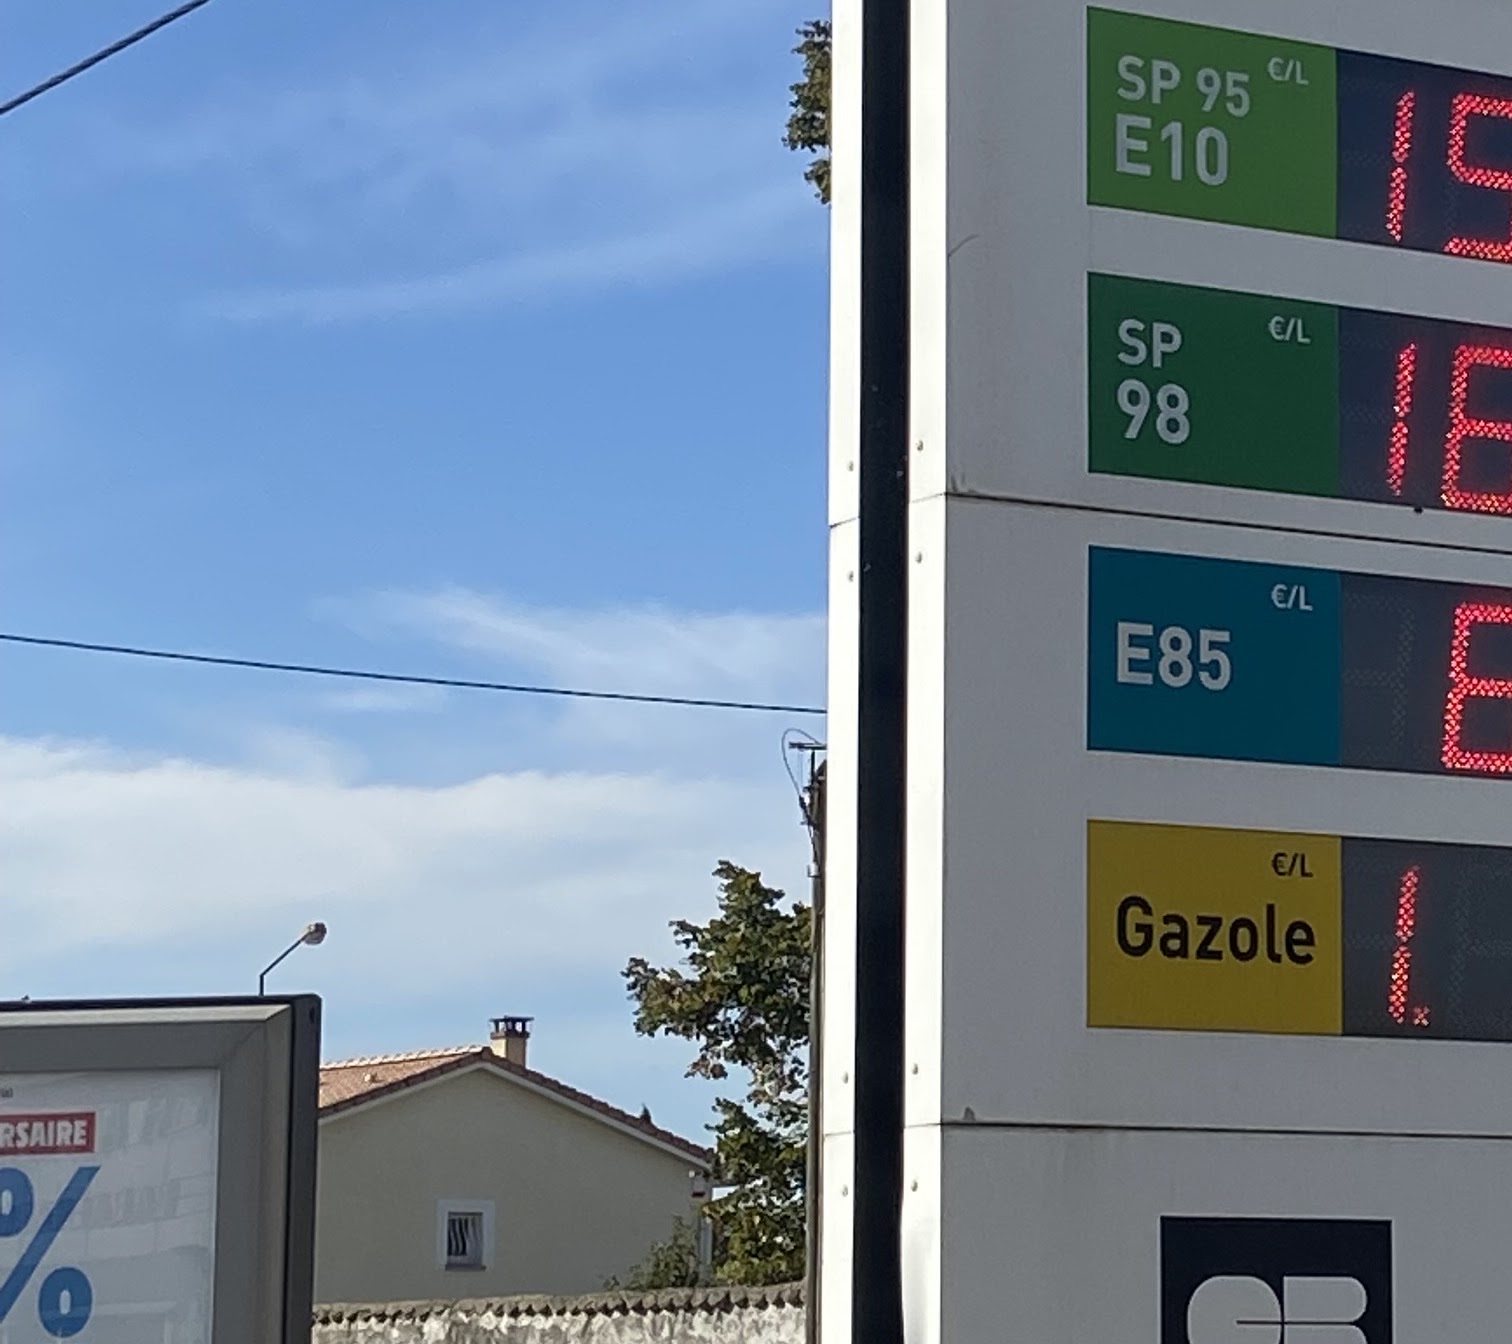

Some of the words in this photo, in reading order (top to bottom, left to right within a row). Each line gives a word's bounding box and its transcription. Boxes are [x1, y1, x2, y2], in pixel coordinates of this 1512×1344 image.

[1117, 55, 1181, 104] SP
[1197, 68, 1251, 117] 95
[1267, 57, 1309, 85] €/L
[1116, 113, 1229, 186] E10
[1117, 319, 1182, 368] SP
[1268, 315, 1311, 344] €/L
[1117, 379, 1190, 444] 98
[1271, 583, 1313, 611] €/L
[1117, 622, 1231, 691] E85
[1272, 852, 1314, 877] €/L
[1117, 895, 1316, 965] Gazole
